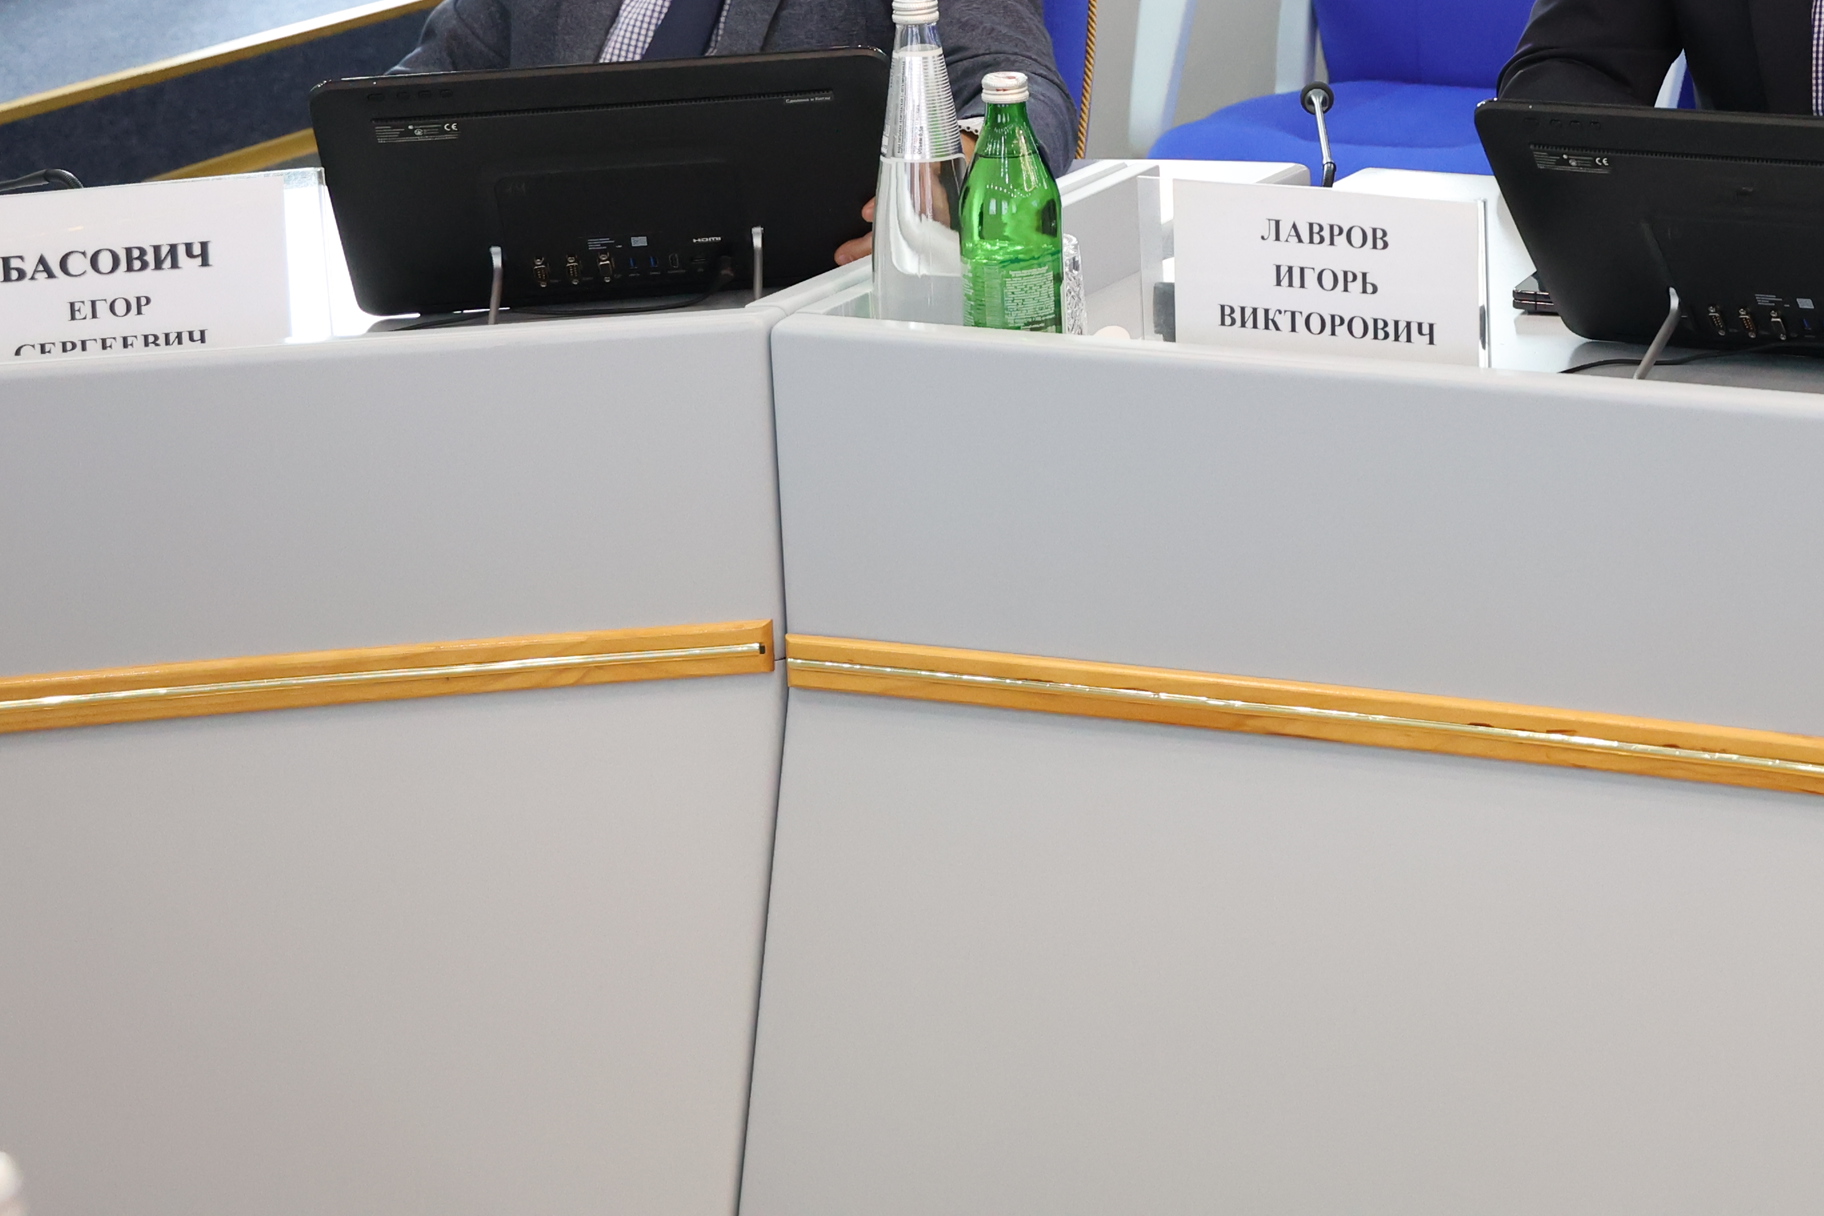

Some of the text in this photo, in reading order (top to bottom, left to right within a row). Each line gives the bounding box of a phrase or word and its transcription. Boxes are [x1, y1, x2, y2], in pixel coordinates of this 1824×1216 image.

[1260, 218, 1389, 251] ЛАВРОВ
[1273, 263, 1379, 295] ИГОРЬ
[68, 295, 152, 322] ЕГОР
[1217, 303, 1437, 346] ВИКТОРОВИЧ
